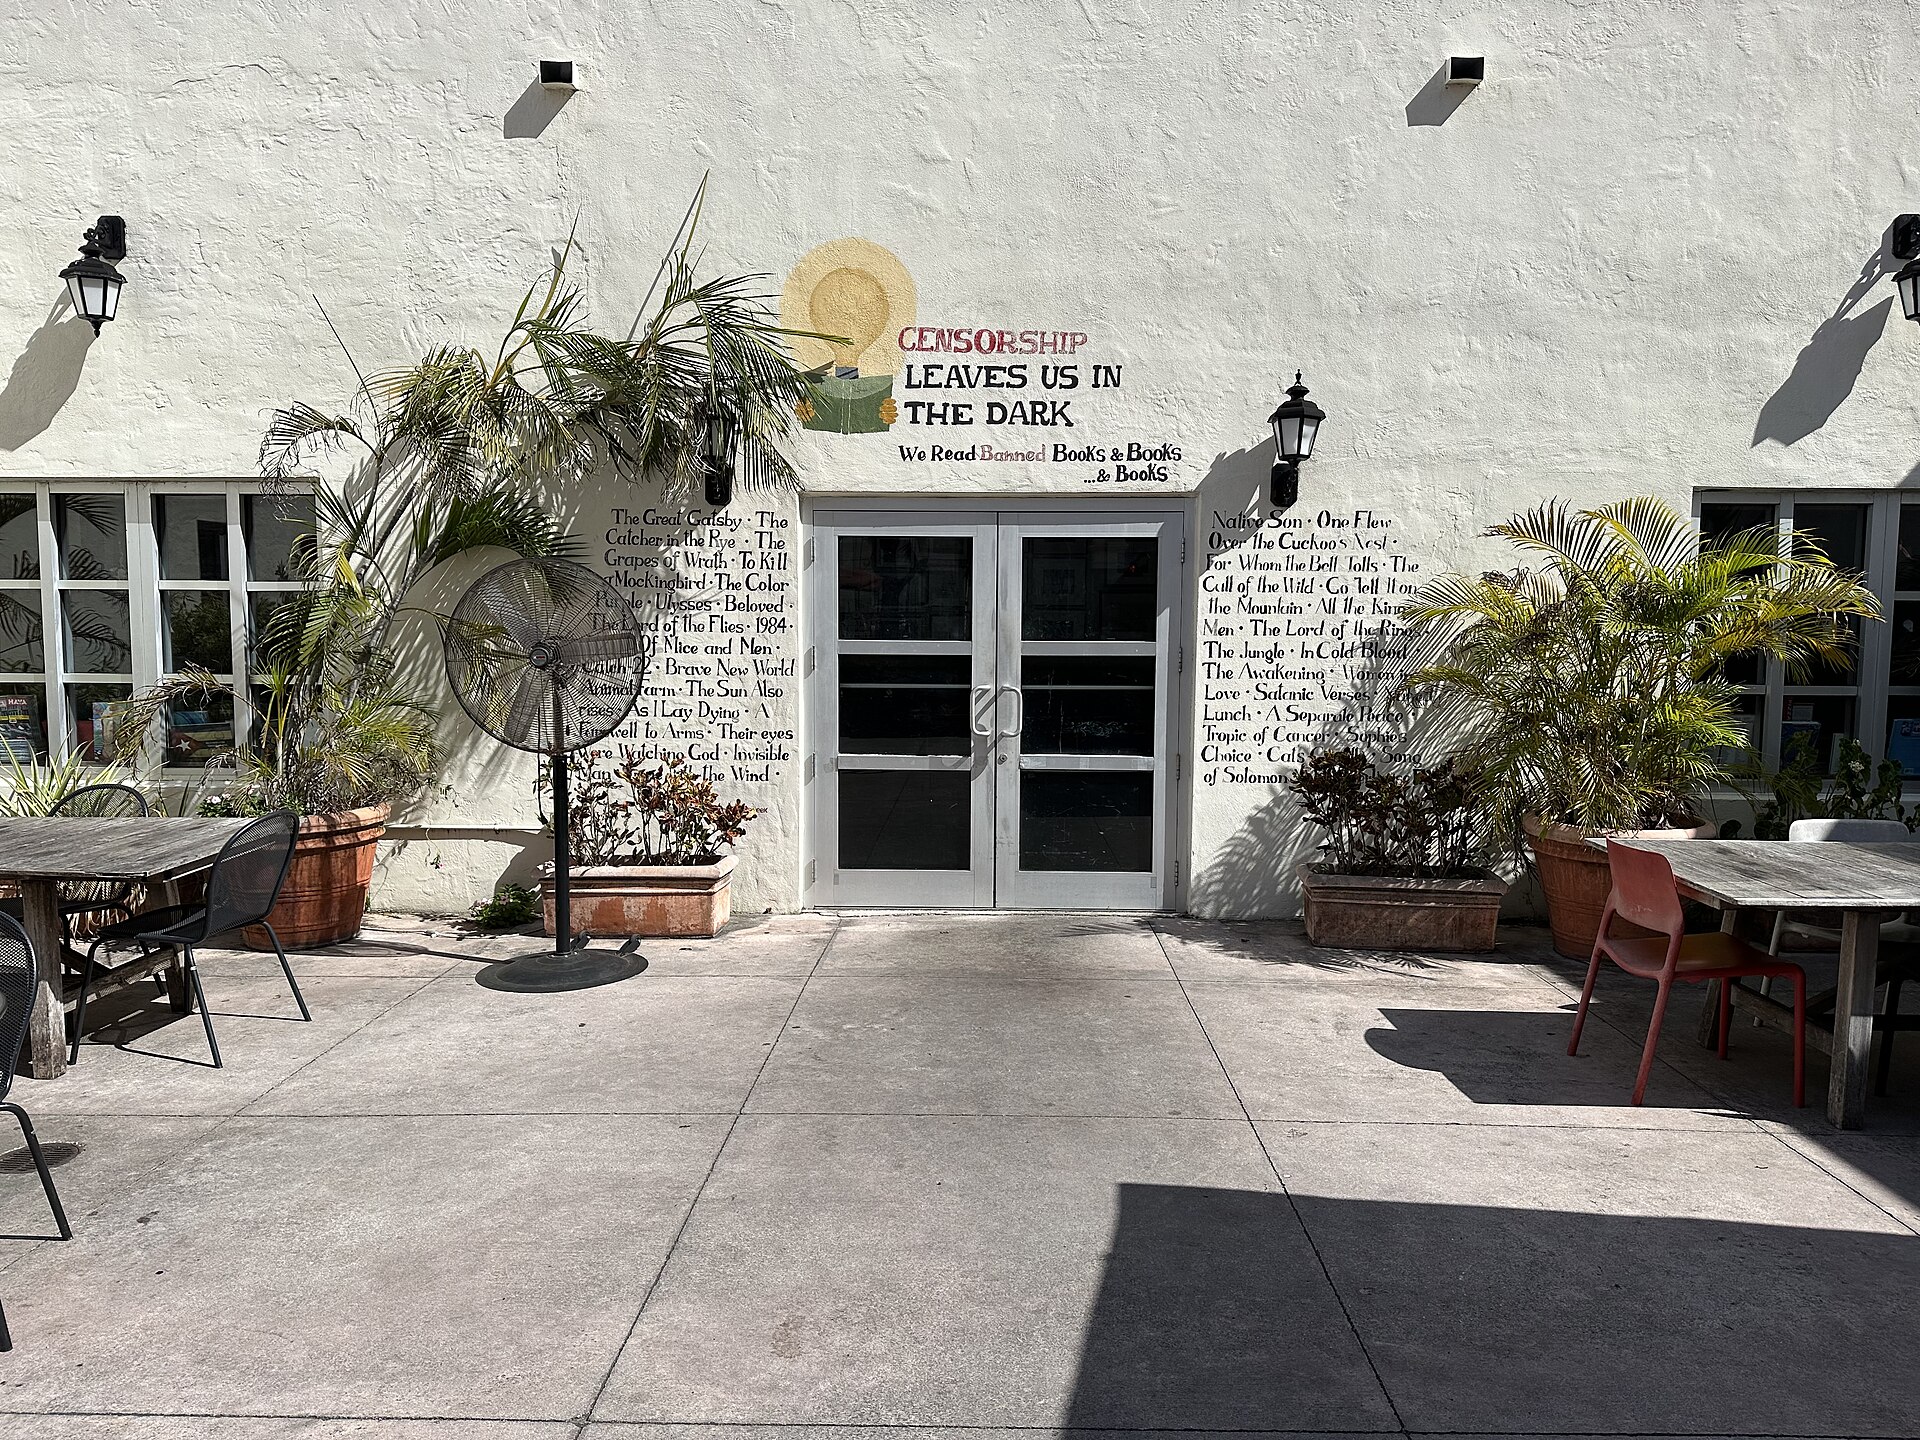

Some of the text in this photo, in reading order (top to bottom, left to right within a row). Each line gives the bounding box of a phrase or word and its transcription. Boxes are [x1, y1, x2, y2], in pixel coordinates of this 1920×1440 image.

[898, 326, 1088, 355] CENSORSHIP
[904, 364, 1122, 390] LEAVES US IN
[904, 400, 1074, 427] THE DARK
[898, 445, 926, 462] We
[931, 444, 976, 462] Read
[980, 444, 1046, 463] Banned
[1110, 448, 1124, 462] &
[611, 509, 788, 531] The Great Gatsby The
[1211, 509, 1392, 529] Native Son One Flew
[605, 528, 786, 551] Catcher in the Rye The
[1208, 531, 1247, 550] Over
[1252, 532, 1274, 550] the
[1355, 532, 1388, 550] Nest
[604, 549, 788, 571] Grapes of Wrath To Kill
[1206, 553, 1420, 573] For Whom the Bell Tolls The
[615, 570, 706, 594] Mockingbird
[714, 572, 742, 591] The
[745, 572, 790, 592] Color
[1202, 575, 1233, 593] Call
[1237, 575, 1254, 598] of
[1257, 576, 1279, 593] the
[1282, 577, 1314, 594] Wild
[1325, 577, 1349, 595] Go
[1353, 577, 1379, 595] Tell
[1399, 584, 1417, 595] on
[655, 592, 712, 615] Ulysses
[724, 595, 784, 613] Beloved
[1208, 597, 1231, 615] the
[1237, 596, 1303, 615] Mountain
[1315, 597, 1336, 615] All
[1344, 597, 1365, 615] the
[621, 614, 660, 633] Lrd
[663, 617, 679, 637] of
[683, 614, 705, 633] the
[709, 615, 744, 633] Flies
[756, 617, 788, 634] 1984
[1203, 619, 1234, 636] Men
[1250, 619, 1280, 637] The
[1286, 619, 1325, 637] Lord
[1331, 619, 1349, 640] of
[1354, 619, 1375, 637] the
[664, 636, 698, 655] Mice
[704, 637, 732, 655] and
[740, 636, 772, 655] Men
[1203, 640, 1408, 664] The Jungle In Cold Blood
[665, 657, 712, 676] Brave
[716, 658, 748, 676] New
[752, 658, 796, 677] World
[1202, 662, 1234, 680] The
[1238, 662, 1326, 685] Awakening
[1343, 664, 1394, 680] Women
[685, 679, 715, 698] The
[717, 679, 748, 697] Sun
[751, 679, 784, 698] Also
[1204, 684, 1240, 700] Love
[1253, 682, 1314, 701] Satanic
[1321, 685, 1371, 701] Verses
[630, 702, 649, 717] As
[654, 700, 658, 717] I
[661, 700, 693, 722] Lay
[698, 700, 740, 724] Dying
[754, 702, 770, 719] A
[1203, 705, 1404, 727] Lunch A Separate Peace
[645, 721, 658, 739] to
[661, 722, 705, 739] Arms
[717, 723, 758, 740] Their
[761, 729, 794, 744] eyes
[1202, 725, 1247, 745] Tropic
[1253, 726, 1269, 747] of
[1273, 726, 1331, 743] Cancer
[688, 743, 719, 761] God
[733, 743, 790, 761] Invisible
[1201, 745, 1252, 763] Choice
[1380, 745, 1422, 768] Song
[702, 764, 725, 781] the
[730, 764, 769, 782] Wind
[1203, 766, 1288, 787] of Solomon
